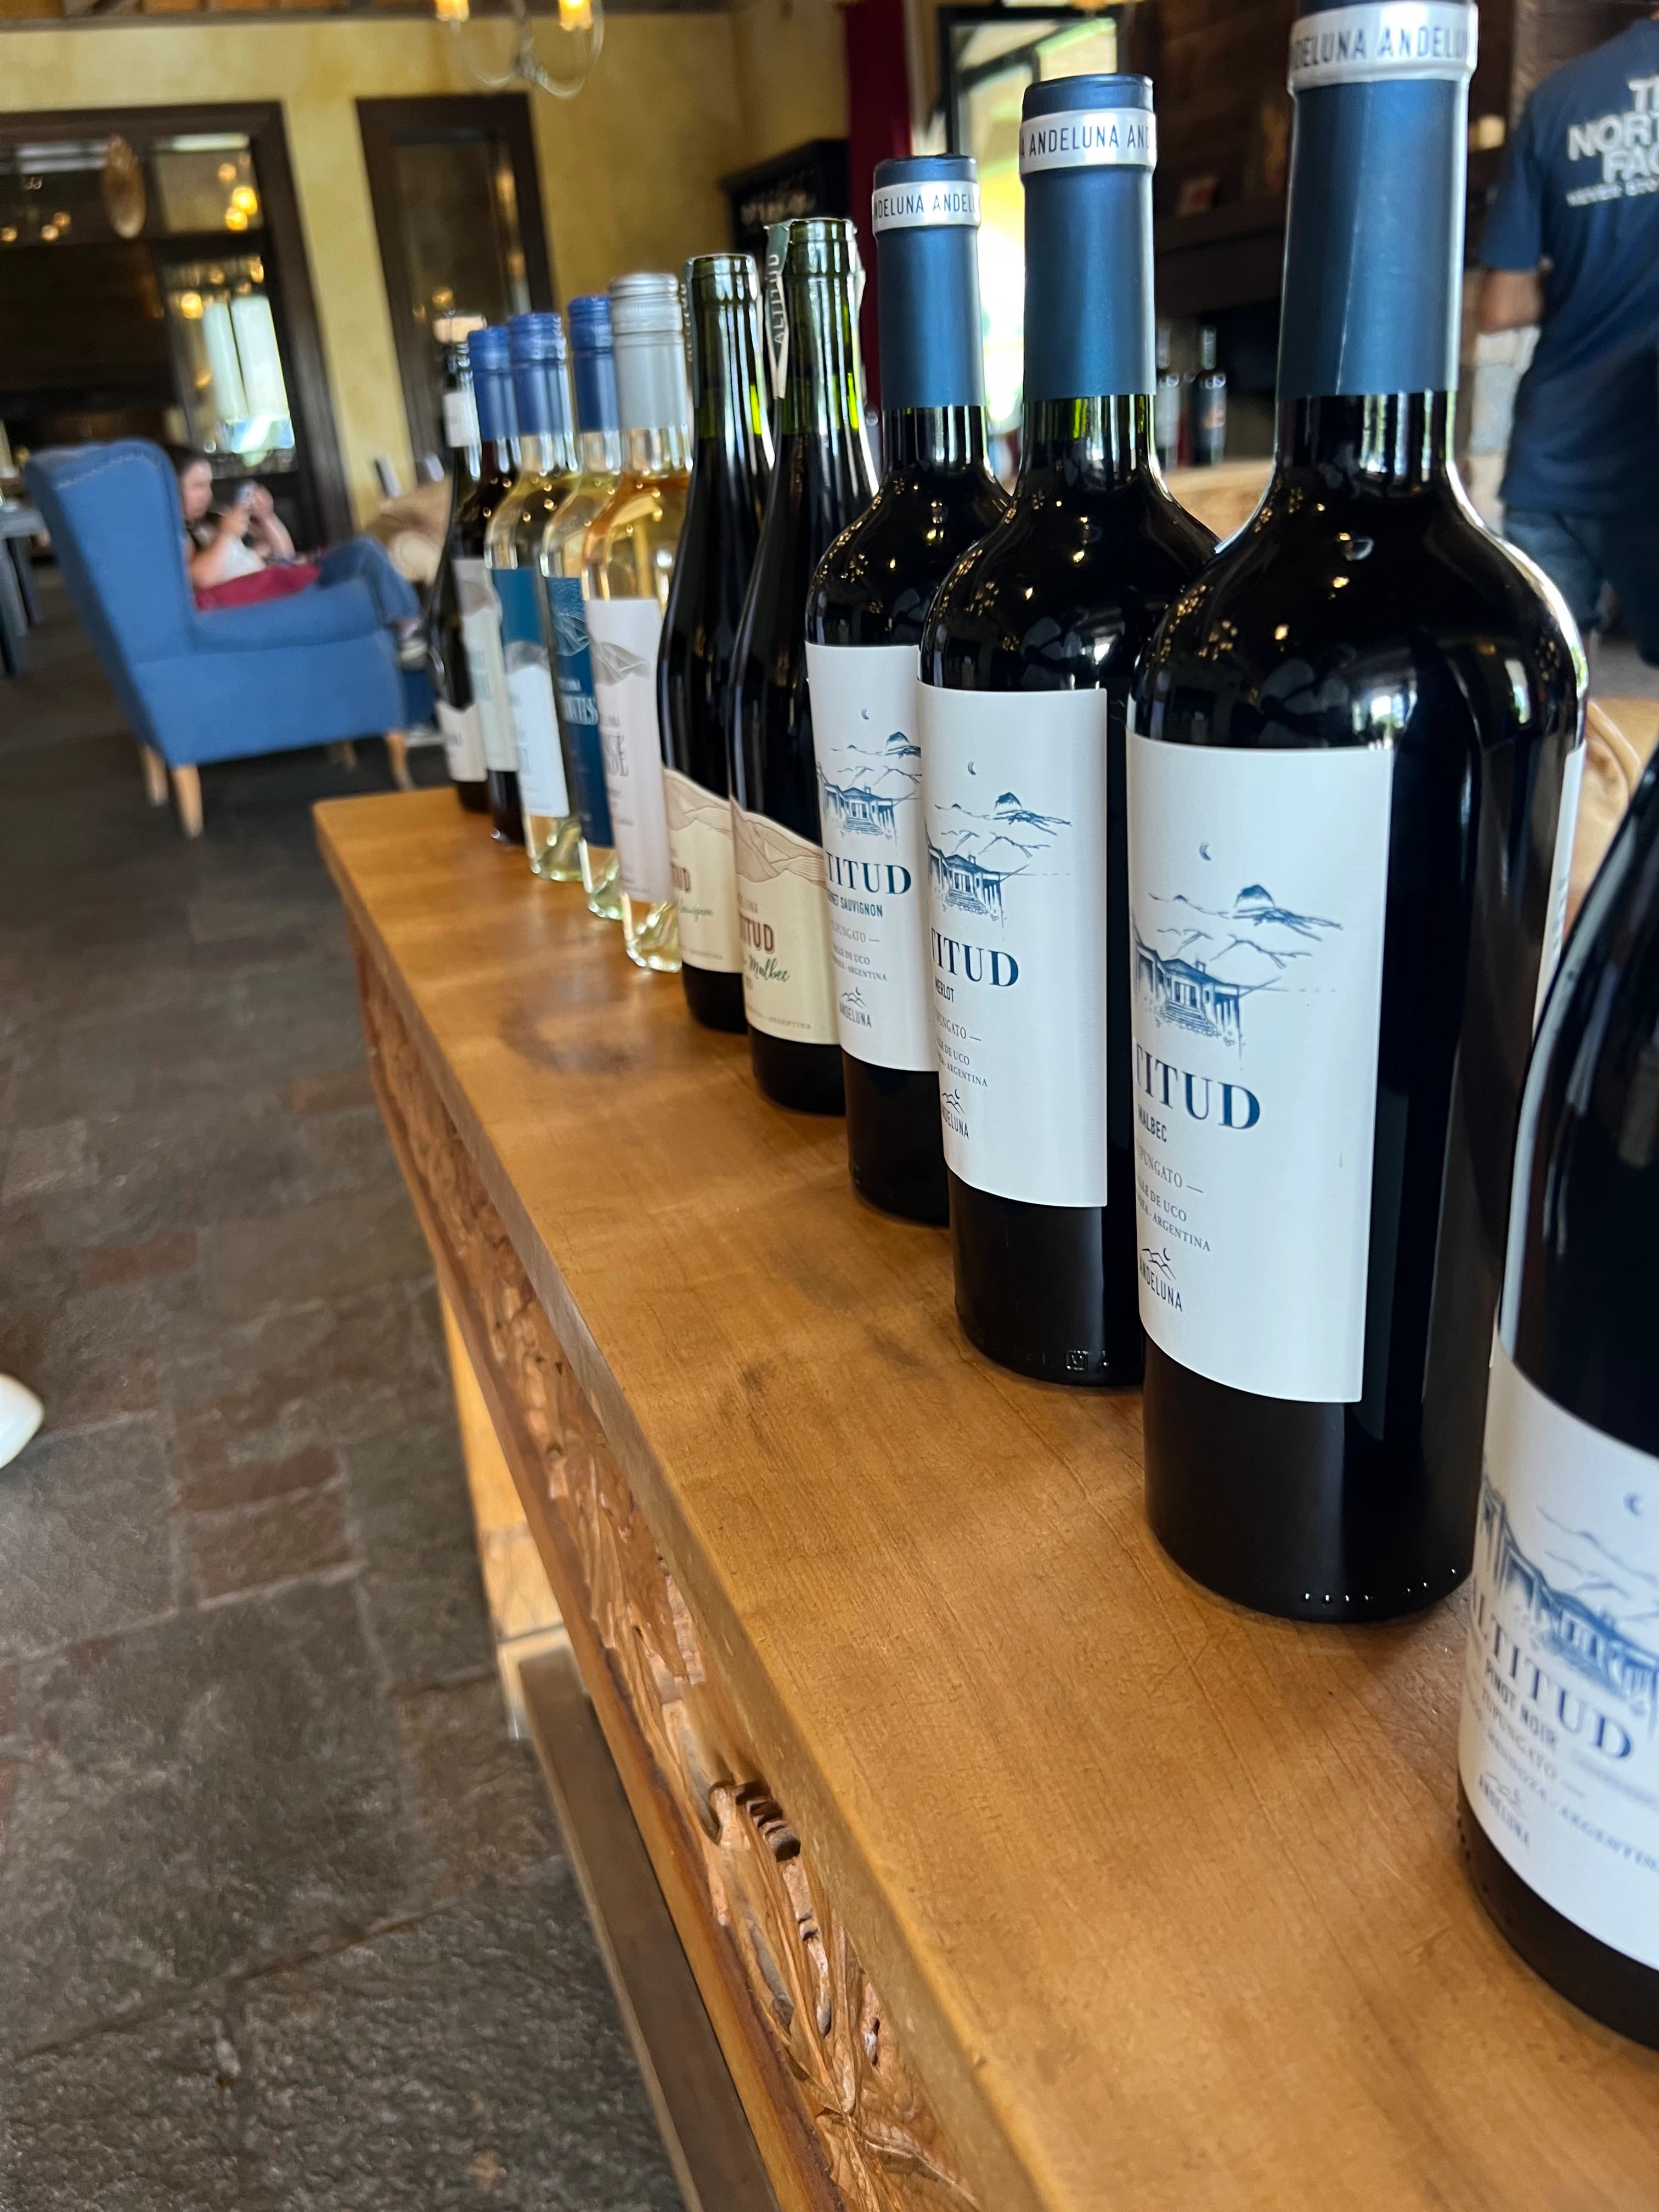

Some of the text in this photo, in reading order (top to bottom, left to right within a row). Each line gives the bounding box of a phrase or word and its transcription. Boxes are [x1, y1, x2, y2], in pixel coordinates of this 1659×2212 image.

[1029, 125, 1119, 157] ANDELUNA
[840, 896, 883, 918] SAUVIGNON
[854, 953, 871, 966] UCO
[848, 965, 887, 981] ARGENTINA
[945, 1043, 952, 1057] DE
[953, 1051, 970, 1066] UCO
[946, 1062, 988, 1087] ARGENTINA
[1150, 1189, 1161, 1207] DE
[1163, 1199, 1187, 1222] UCO
[1153, 1212, 1211, 1252] ARGENTINA
